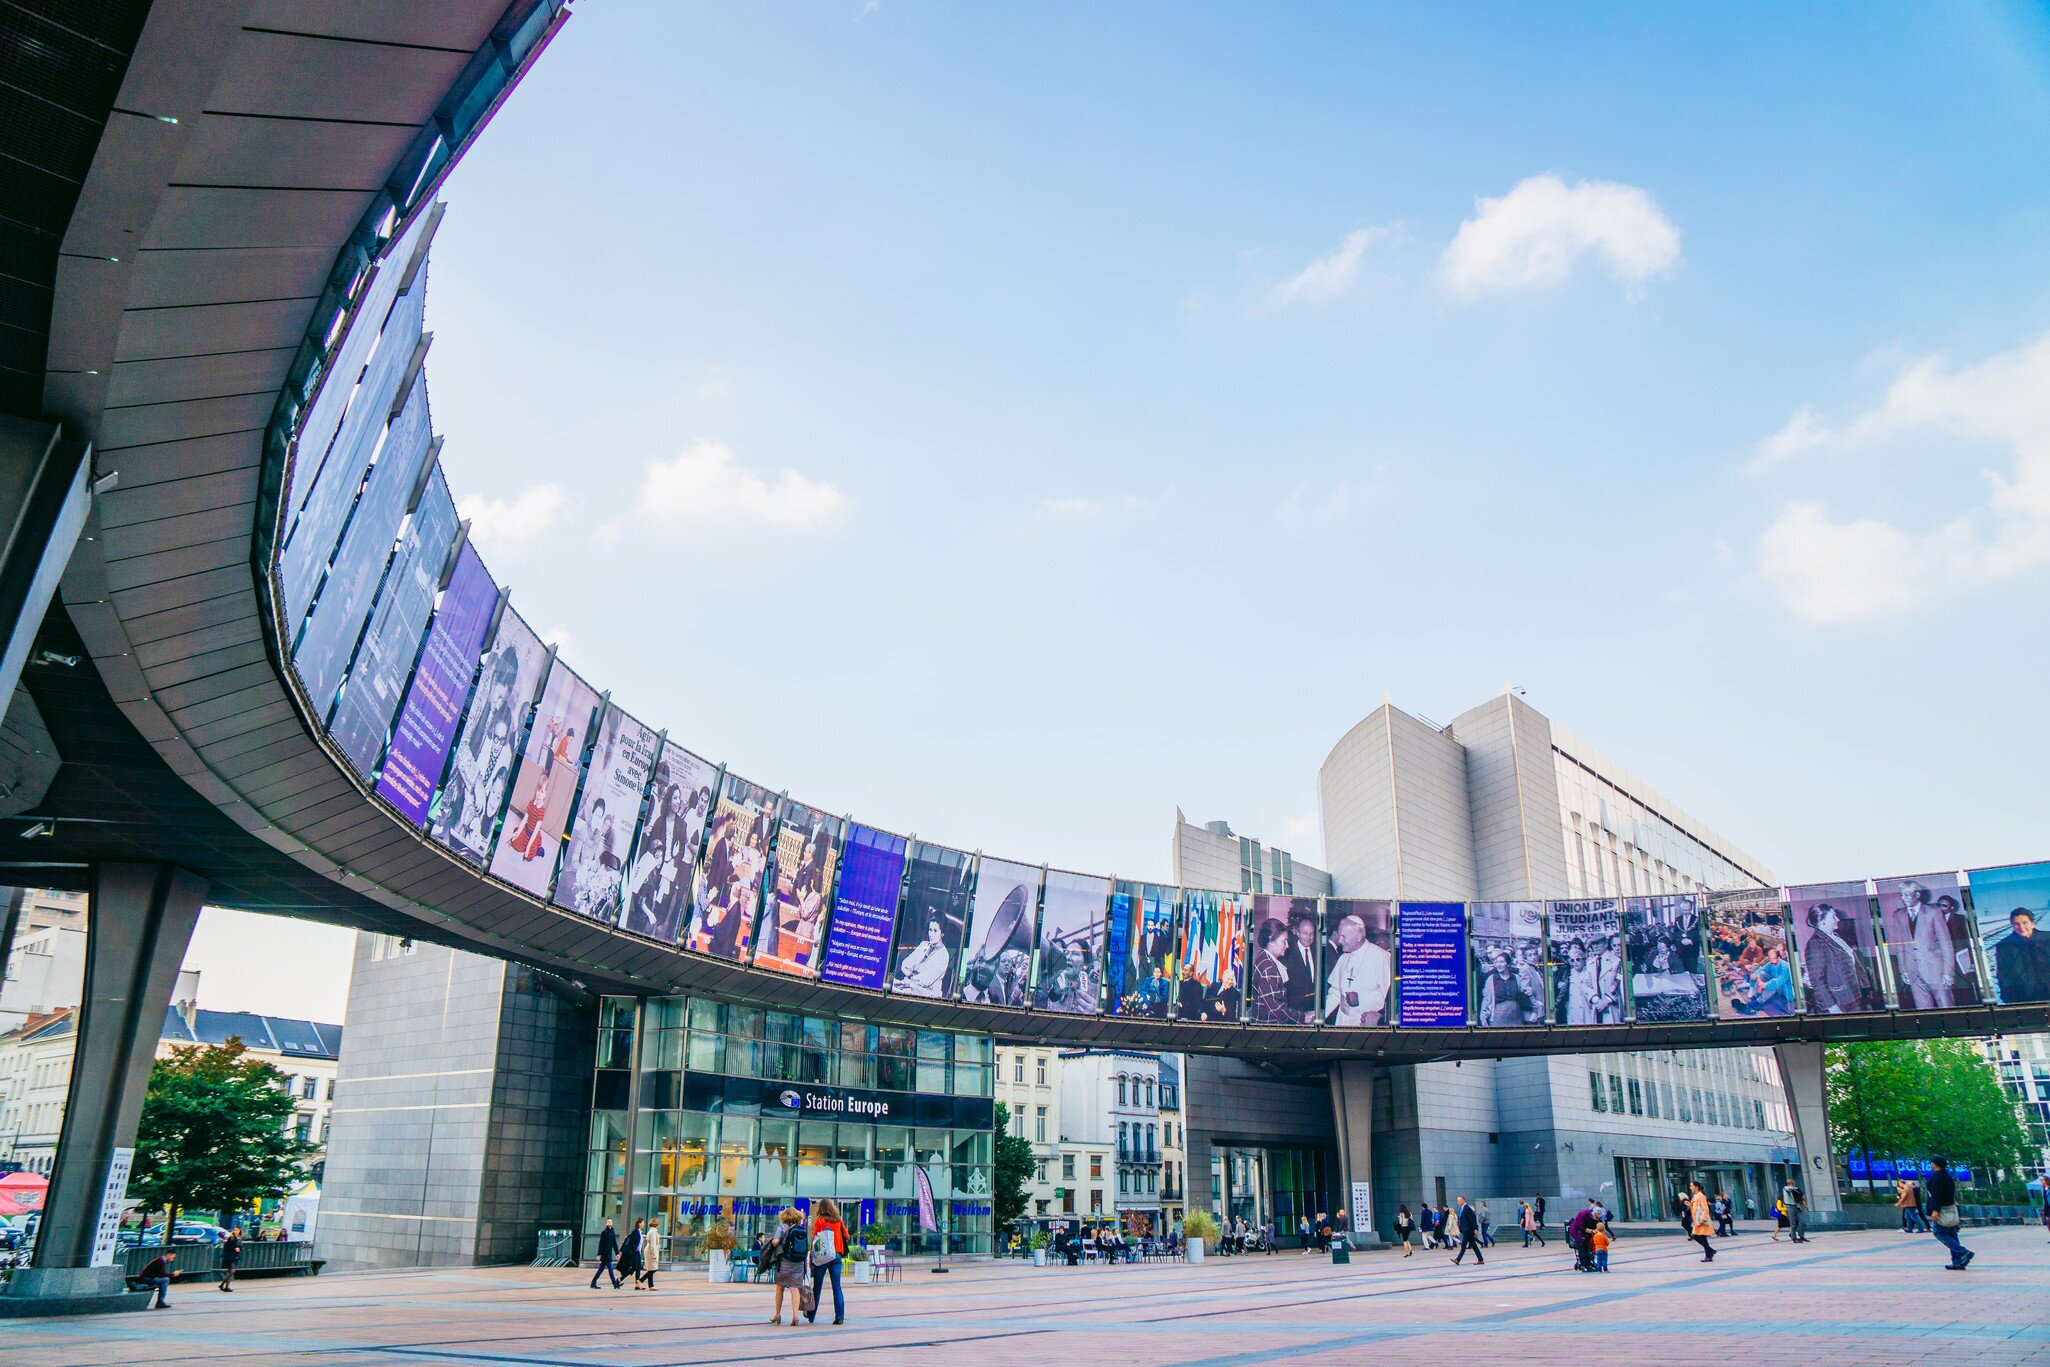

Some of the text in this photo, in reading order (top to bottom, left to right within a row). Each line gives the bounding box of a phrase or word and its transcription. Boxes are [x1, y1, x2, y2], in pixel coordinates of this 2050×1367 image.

[637, 726, 652, 743] Agir
[620, 734, 636, 749] pour
[635, 740, 642, 752] la
[642, 744, 652, 759] Fra
[622, 750, 630, 760] en
[630, 751, 648, 773] Europ
[614, 768, 636, 790] Simone
[628, 766, 642, 780] avec
[1554, 900, 1614, 913] UNION DES
[1554, 910, 1620, 924] ETUDIANTS
[1556, 924, 1586, 933] JUIFS
[1588, 924, 1601, 932] de
[806, 1092, 889, 1118] Station Europe
[681, 1201, 723, 1215] Welcome
[732, 1200, 791, 1215] Willkomme
[886, 1203, 920, 1216] Bienve
[953, 1203, 991, 1216] Welkom
